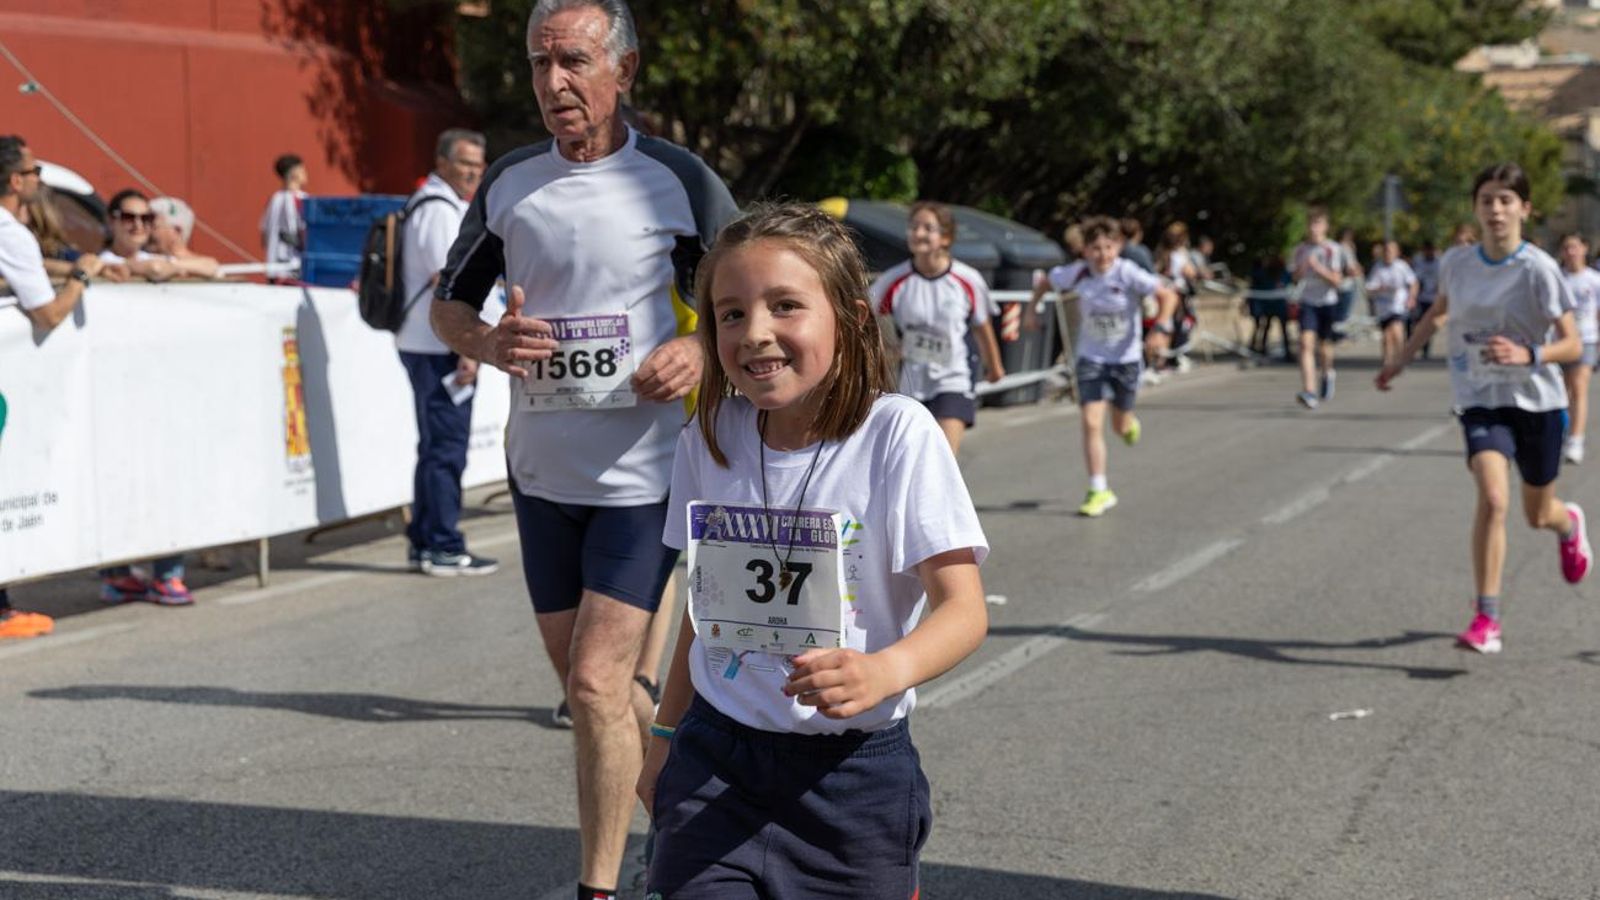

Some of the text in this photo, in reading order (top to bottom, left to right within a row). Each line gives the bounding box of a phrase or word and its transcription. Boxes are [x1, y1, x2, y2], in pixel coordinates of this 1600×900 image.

[531, 348, 617, 380] 1568
[722, 512, 778, 541] XXXVI
[781, 515, 822, 531] CARRERA
[745, 558, 813, 606] 37
